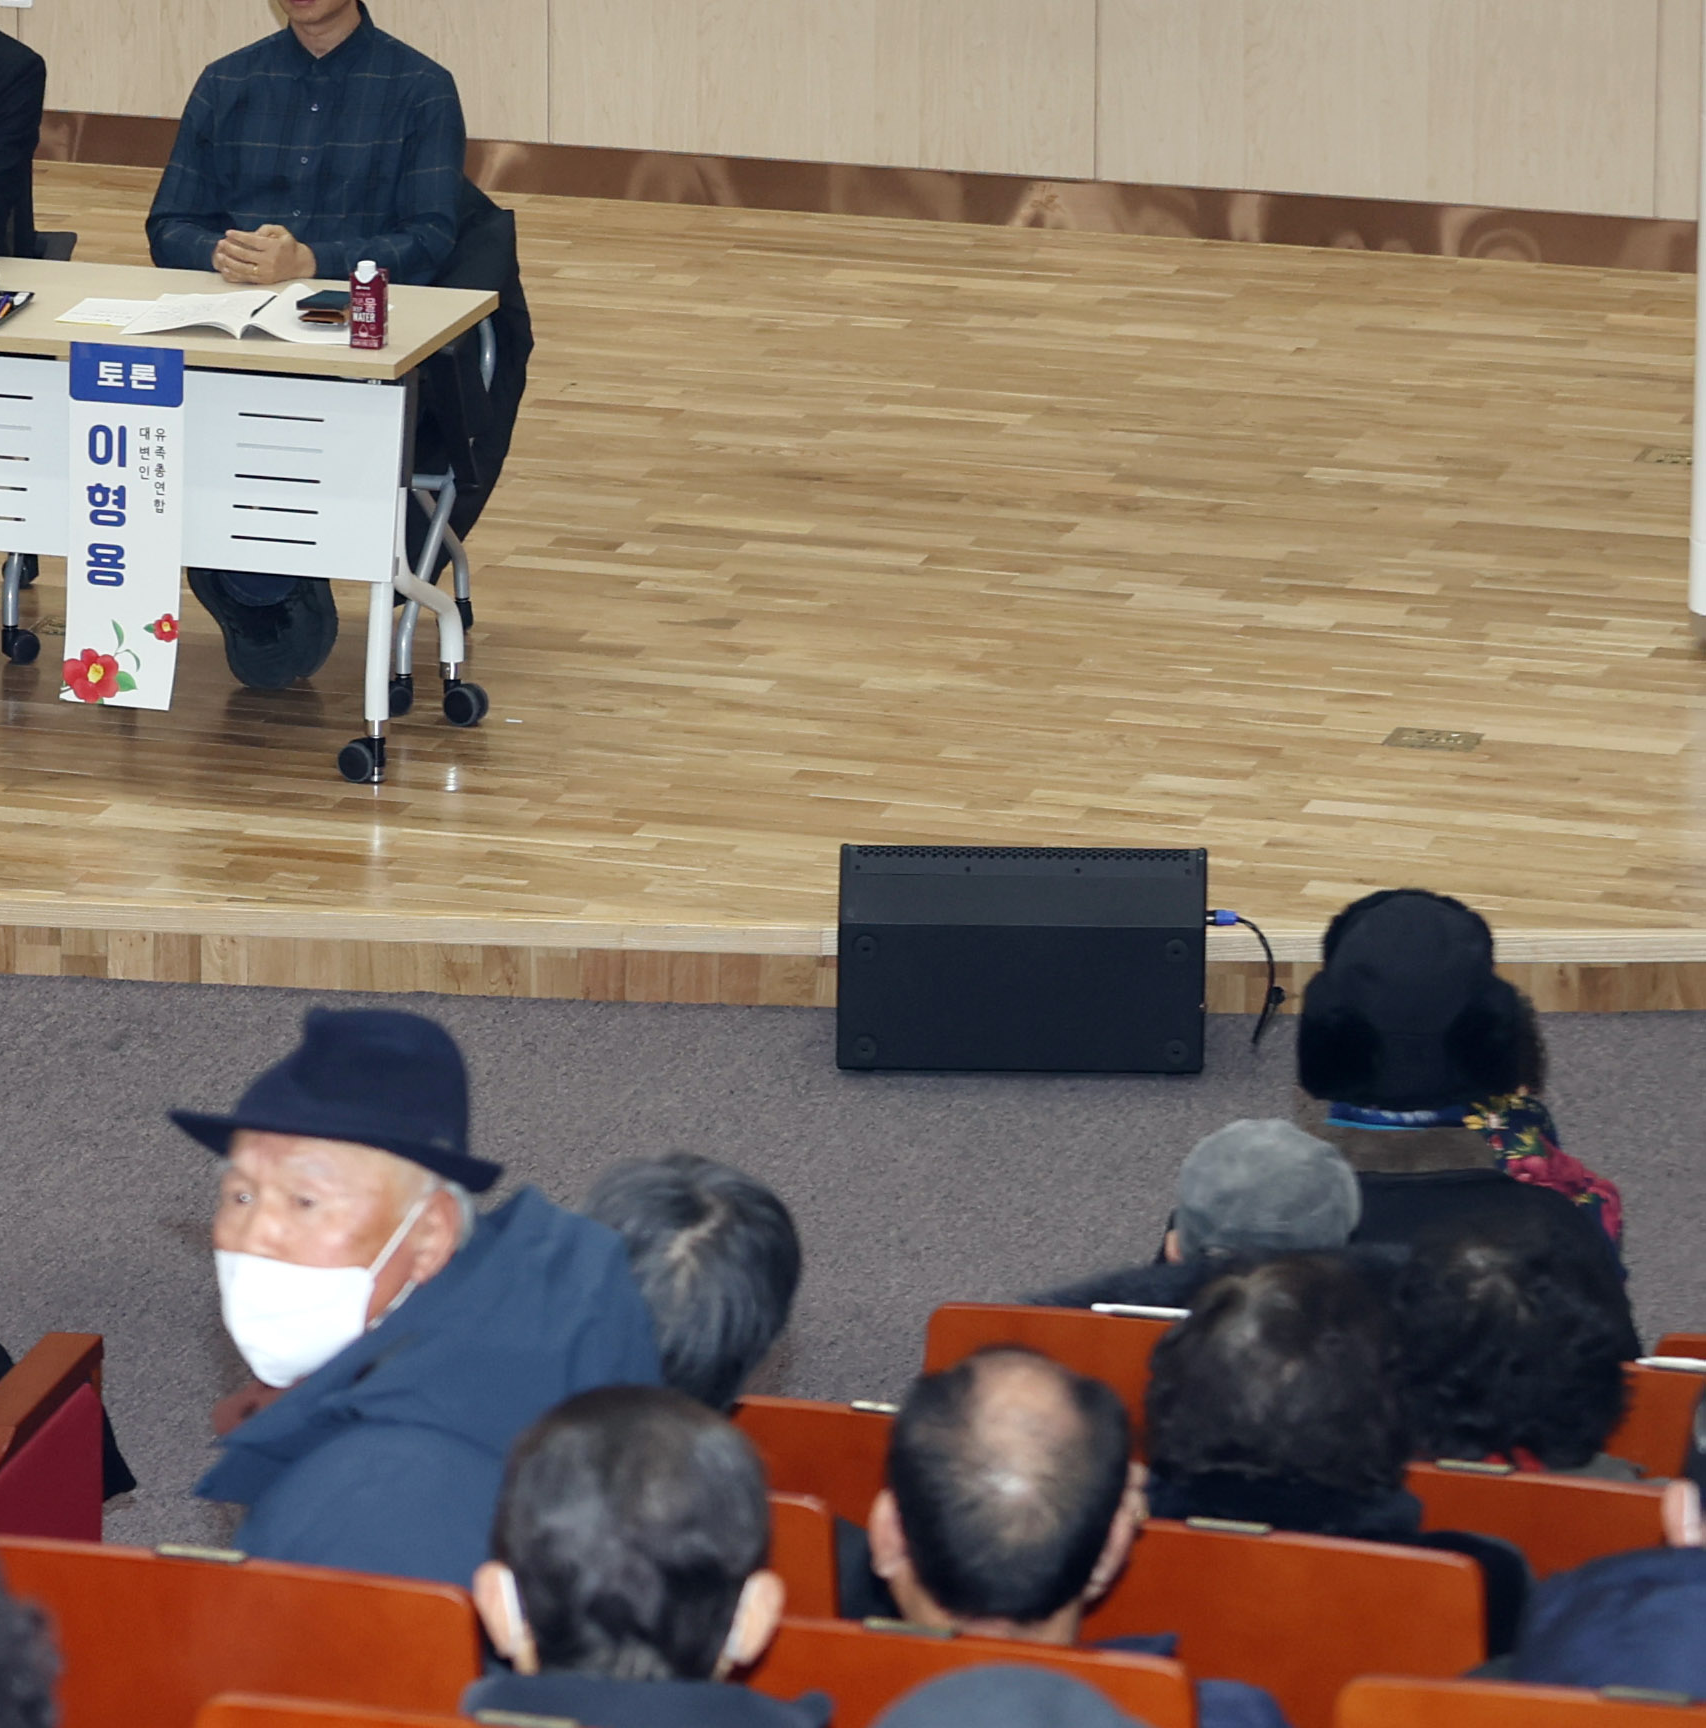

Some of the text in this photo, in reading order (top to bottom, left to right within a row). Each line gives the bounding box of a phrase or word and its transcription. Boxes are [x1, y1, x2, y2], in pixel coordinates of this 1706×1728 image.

[352, 312, 376, 323] WATER
[97, 361, 157, 390] 토론
[85, 424, 127, 587] 이형용
